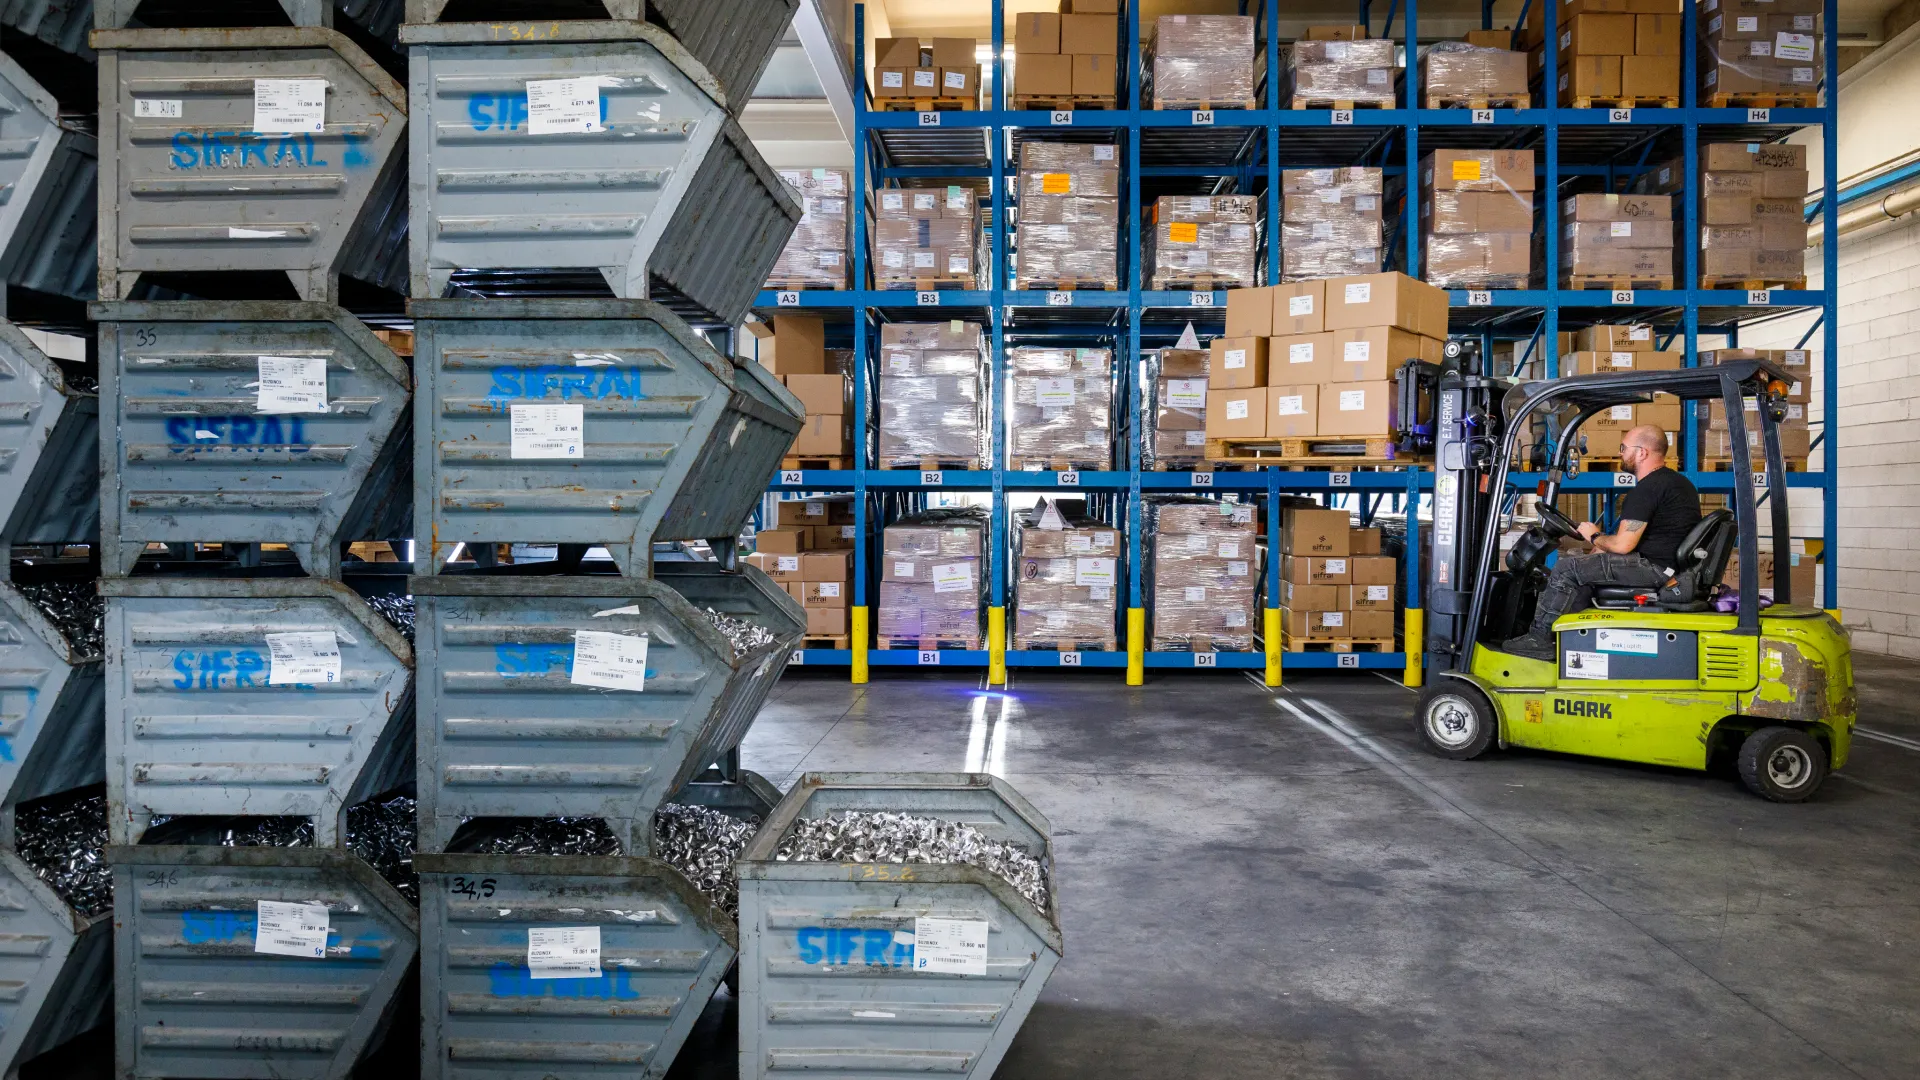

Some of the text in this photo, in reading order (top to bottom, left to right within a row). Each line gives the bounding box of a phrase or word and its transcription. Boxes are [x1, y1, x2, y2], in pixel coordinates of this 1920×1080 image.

[924, 115, 937, 123] B4
[1055, 113, 1069, 122] C4
[1197, 113, 1210, 122] D4
[1336, 113, 1349, 122] E4
[1477, 112, 1490, 121] F4
[1613, 111, 1628, 120] G4
[1752, 111, 1766, 120] H4
[170, 130, 328, 168] SIFRAL
[1766, 204, 1796, 213] SIFRAL
[1722, 229, 1752, 239] SIFRAL
[1766, 254, 1796, 264] SIFRAL
[782, 294, 796, 303] A3
[922, 294, 935, 303] B3
[1196, 294, 1210, 303] D3
[1616, 292, 1631, 301] G3
[1752, 292, 1767, 301] H3
[136, 327, 157, 347] 35
[488, 363, 646, 402] SIFRAL
[1442, 394, 1453, 424] SERVICE
[165, 416, 312, 453] SIFRAL
[785, 474, 799, 482] A2
[925, 474, 939, 482] B2
[1061, 474, 1075, 483] C2
[1195, 475, 1210, 483] D2
[1334, 475, 1347, 484] E2
[1618, 475, 1632, 484] G2
[1438, 496, 1453, 545] CLARK
[922, 653, 936, 662] B1
[1063, 655, 1077, 664] C1
[1198, 655, 1212, 664] D1
[1342, 656, 1355, 665] E1
[1553, 698, 1612, 719] CLARK
[146, 870, 178, 889] 34,6
[451, 876, 496, 900] 34,5
